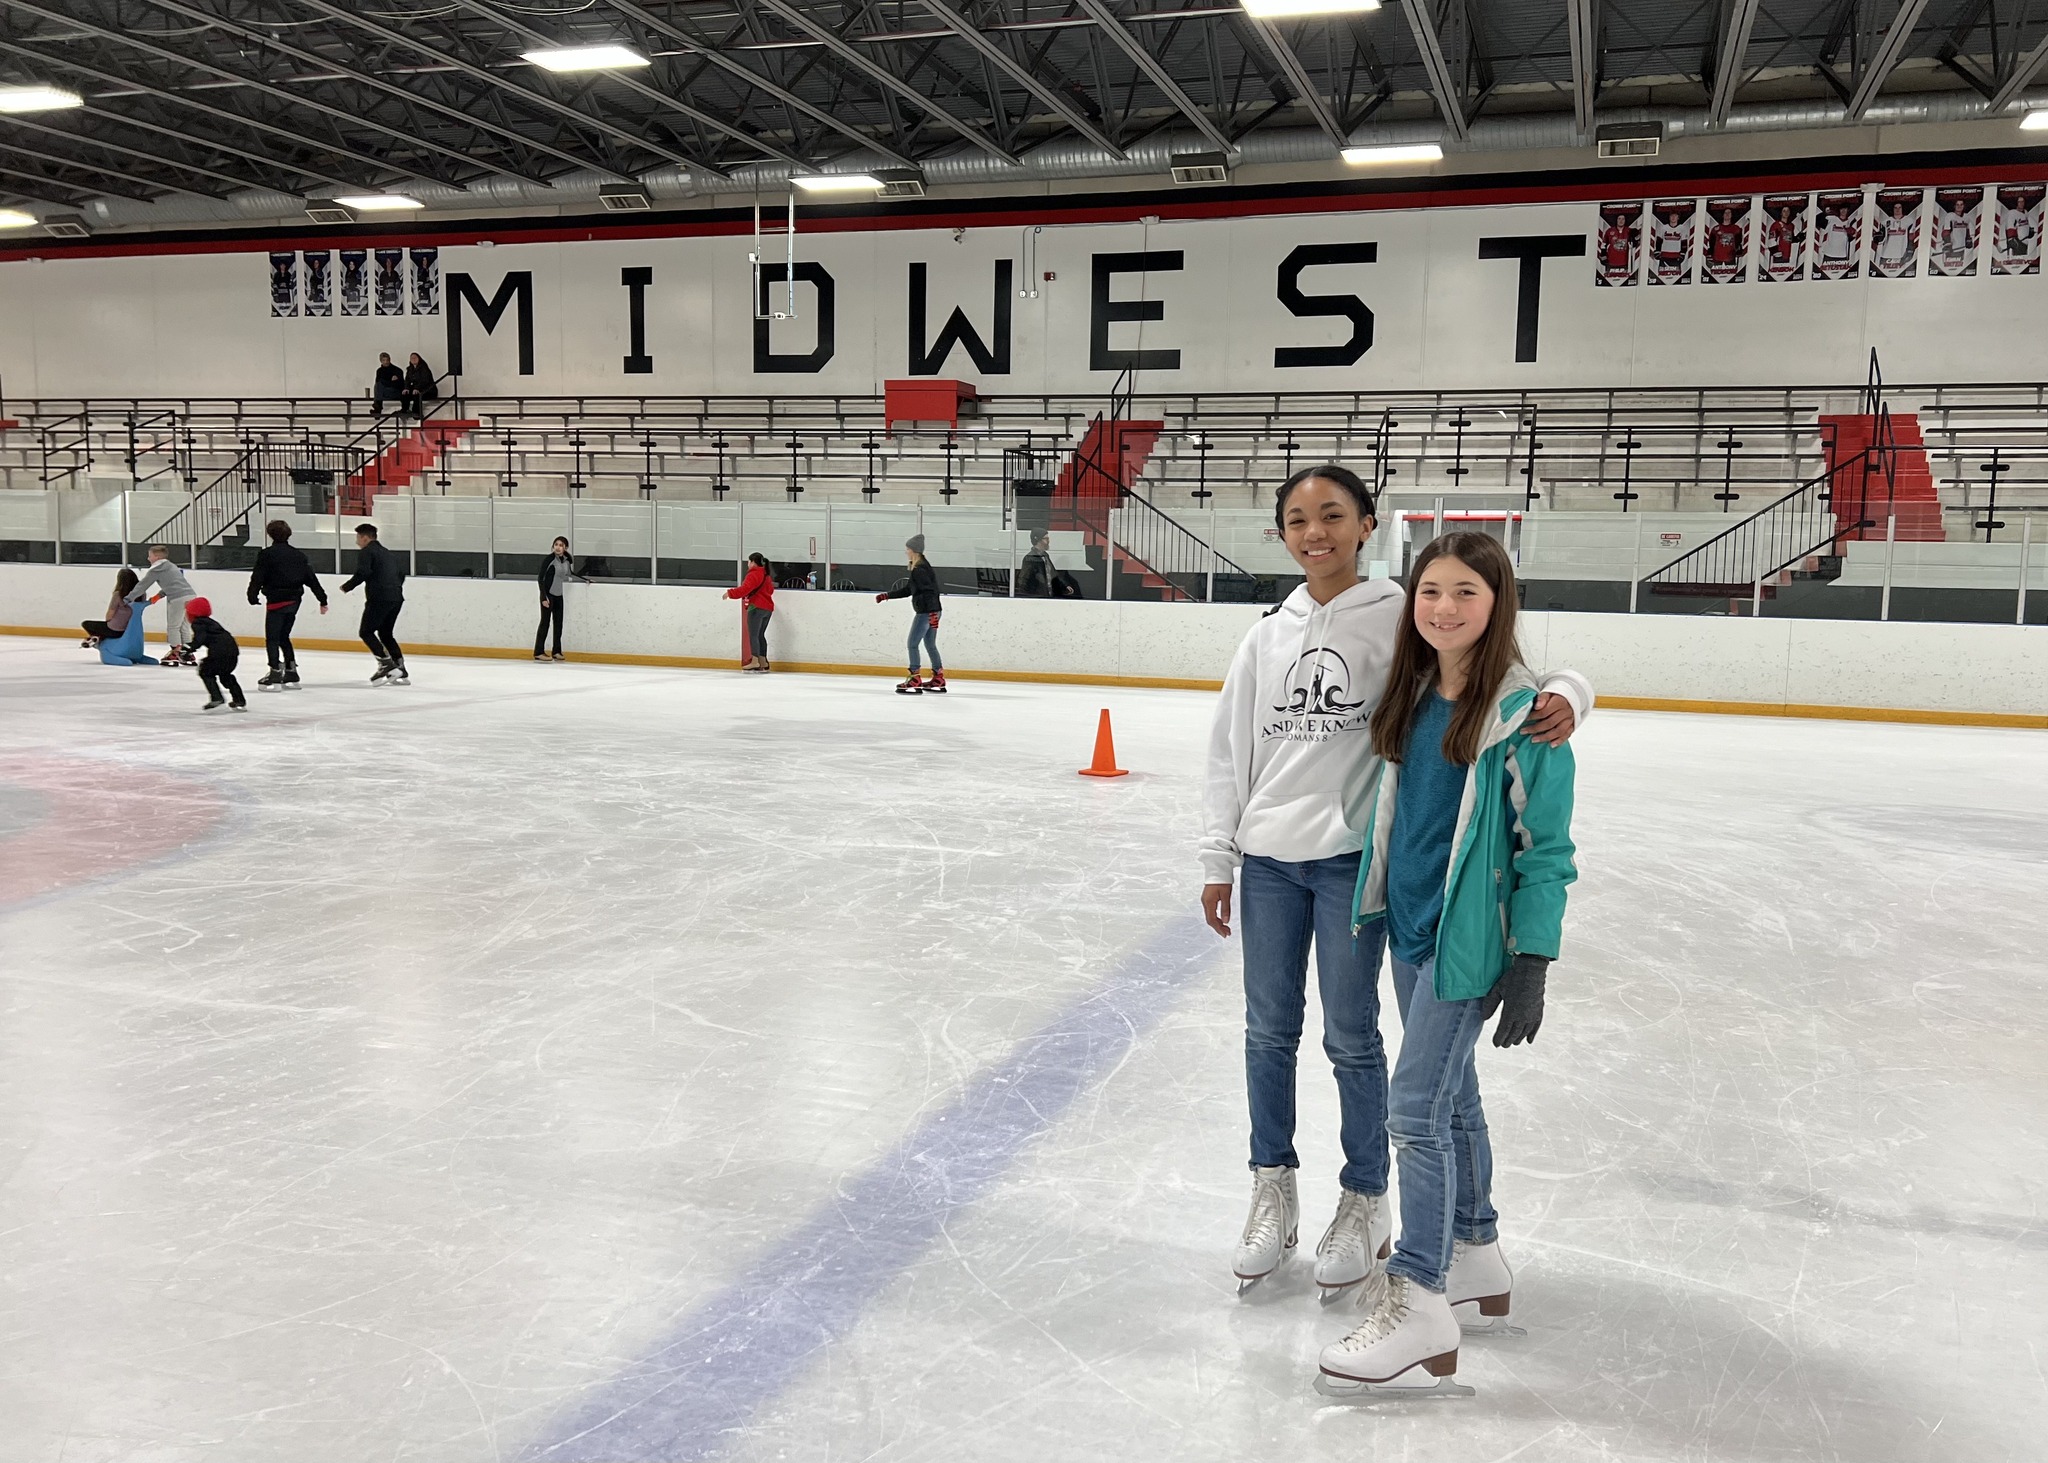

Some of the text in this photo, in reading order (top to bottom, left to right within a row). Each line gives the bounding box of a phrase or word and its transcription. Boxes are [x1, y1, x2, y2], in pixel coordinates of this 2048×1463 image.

[444, 234, 1586, 377] MIDWEST
[1261, 720, 1293, 738] AND
[1285, 733, 1320, 742] OMANS
